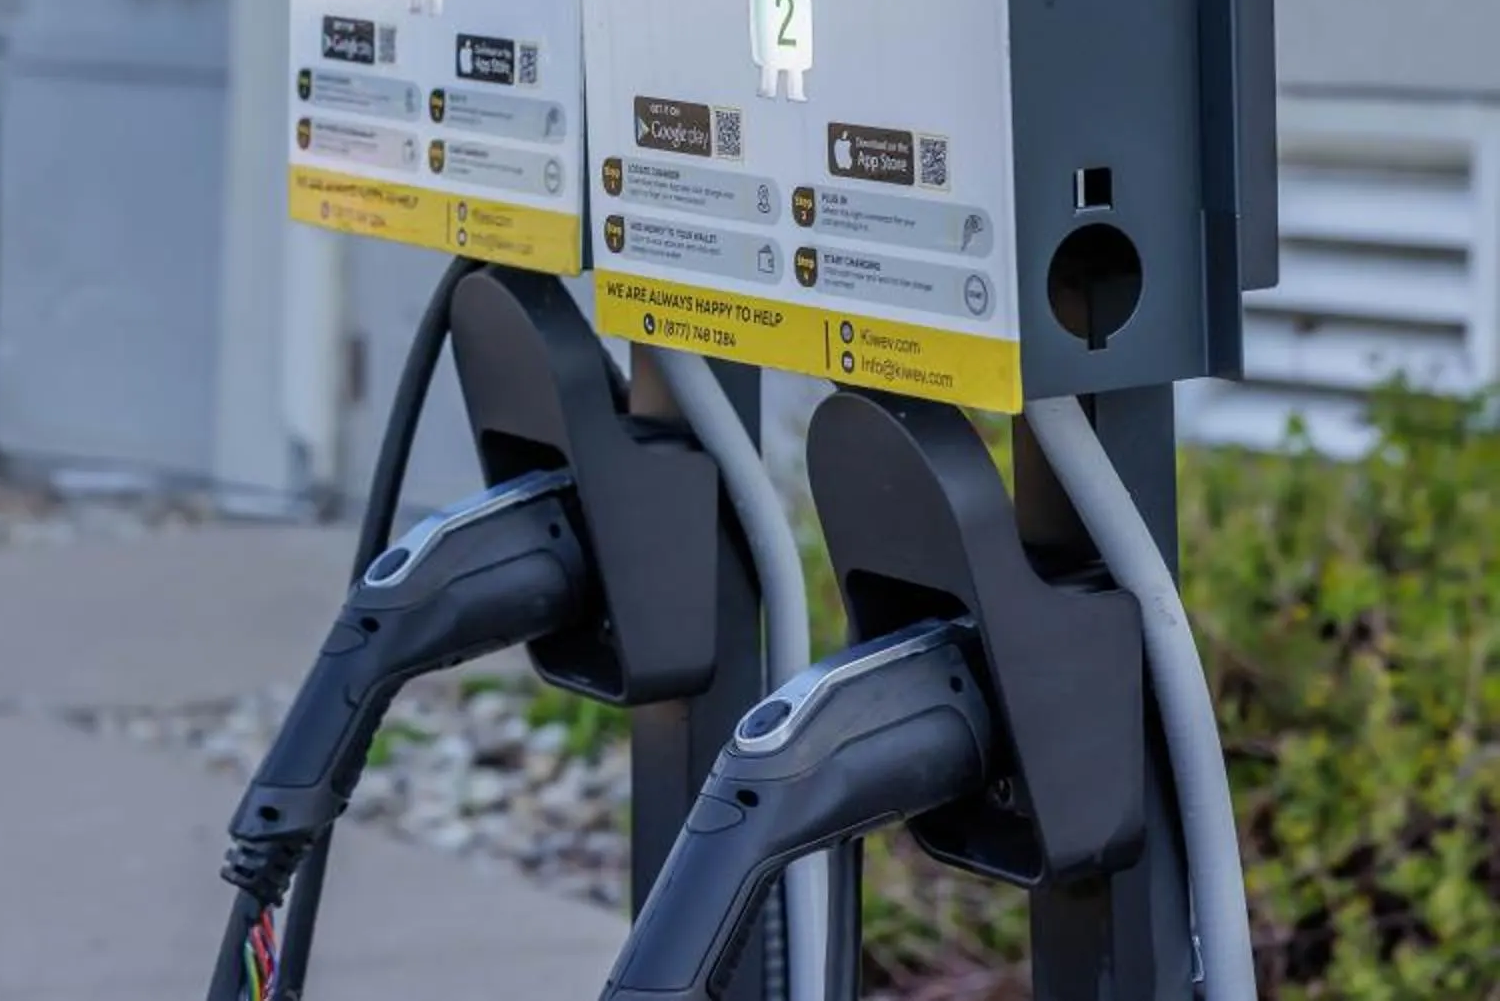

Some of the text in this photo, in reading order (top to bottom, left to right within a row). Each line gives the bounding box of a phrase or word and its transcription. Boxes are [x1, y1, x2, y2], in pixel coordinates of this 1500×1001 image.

[651, 121, 687, 148] Google
[857, 150, 907, 172] App Store
[607, 281, 784, 327] WE ARE ALWAYS HAPPY TO HELP
[663, 318, 691, 341] (877)
